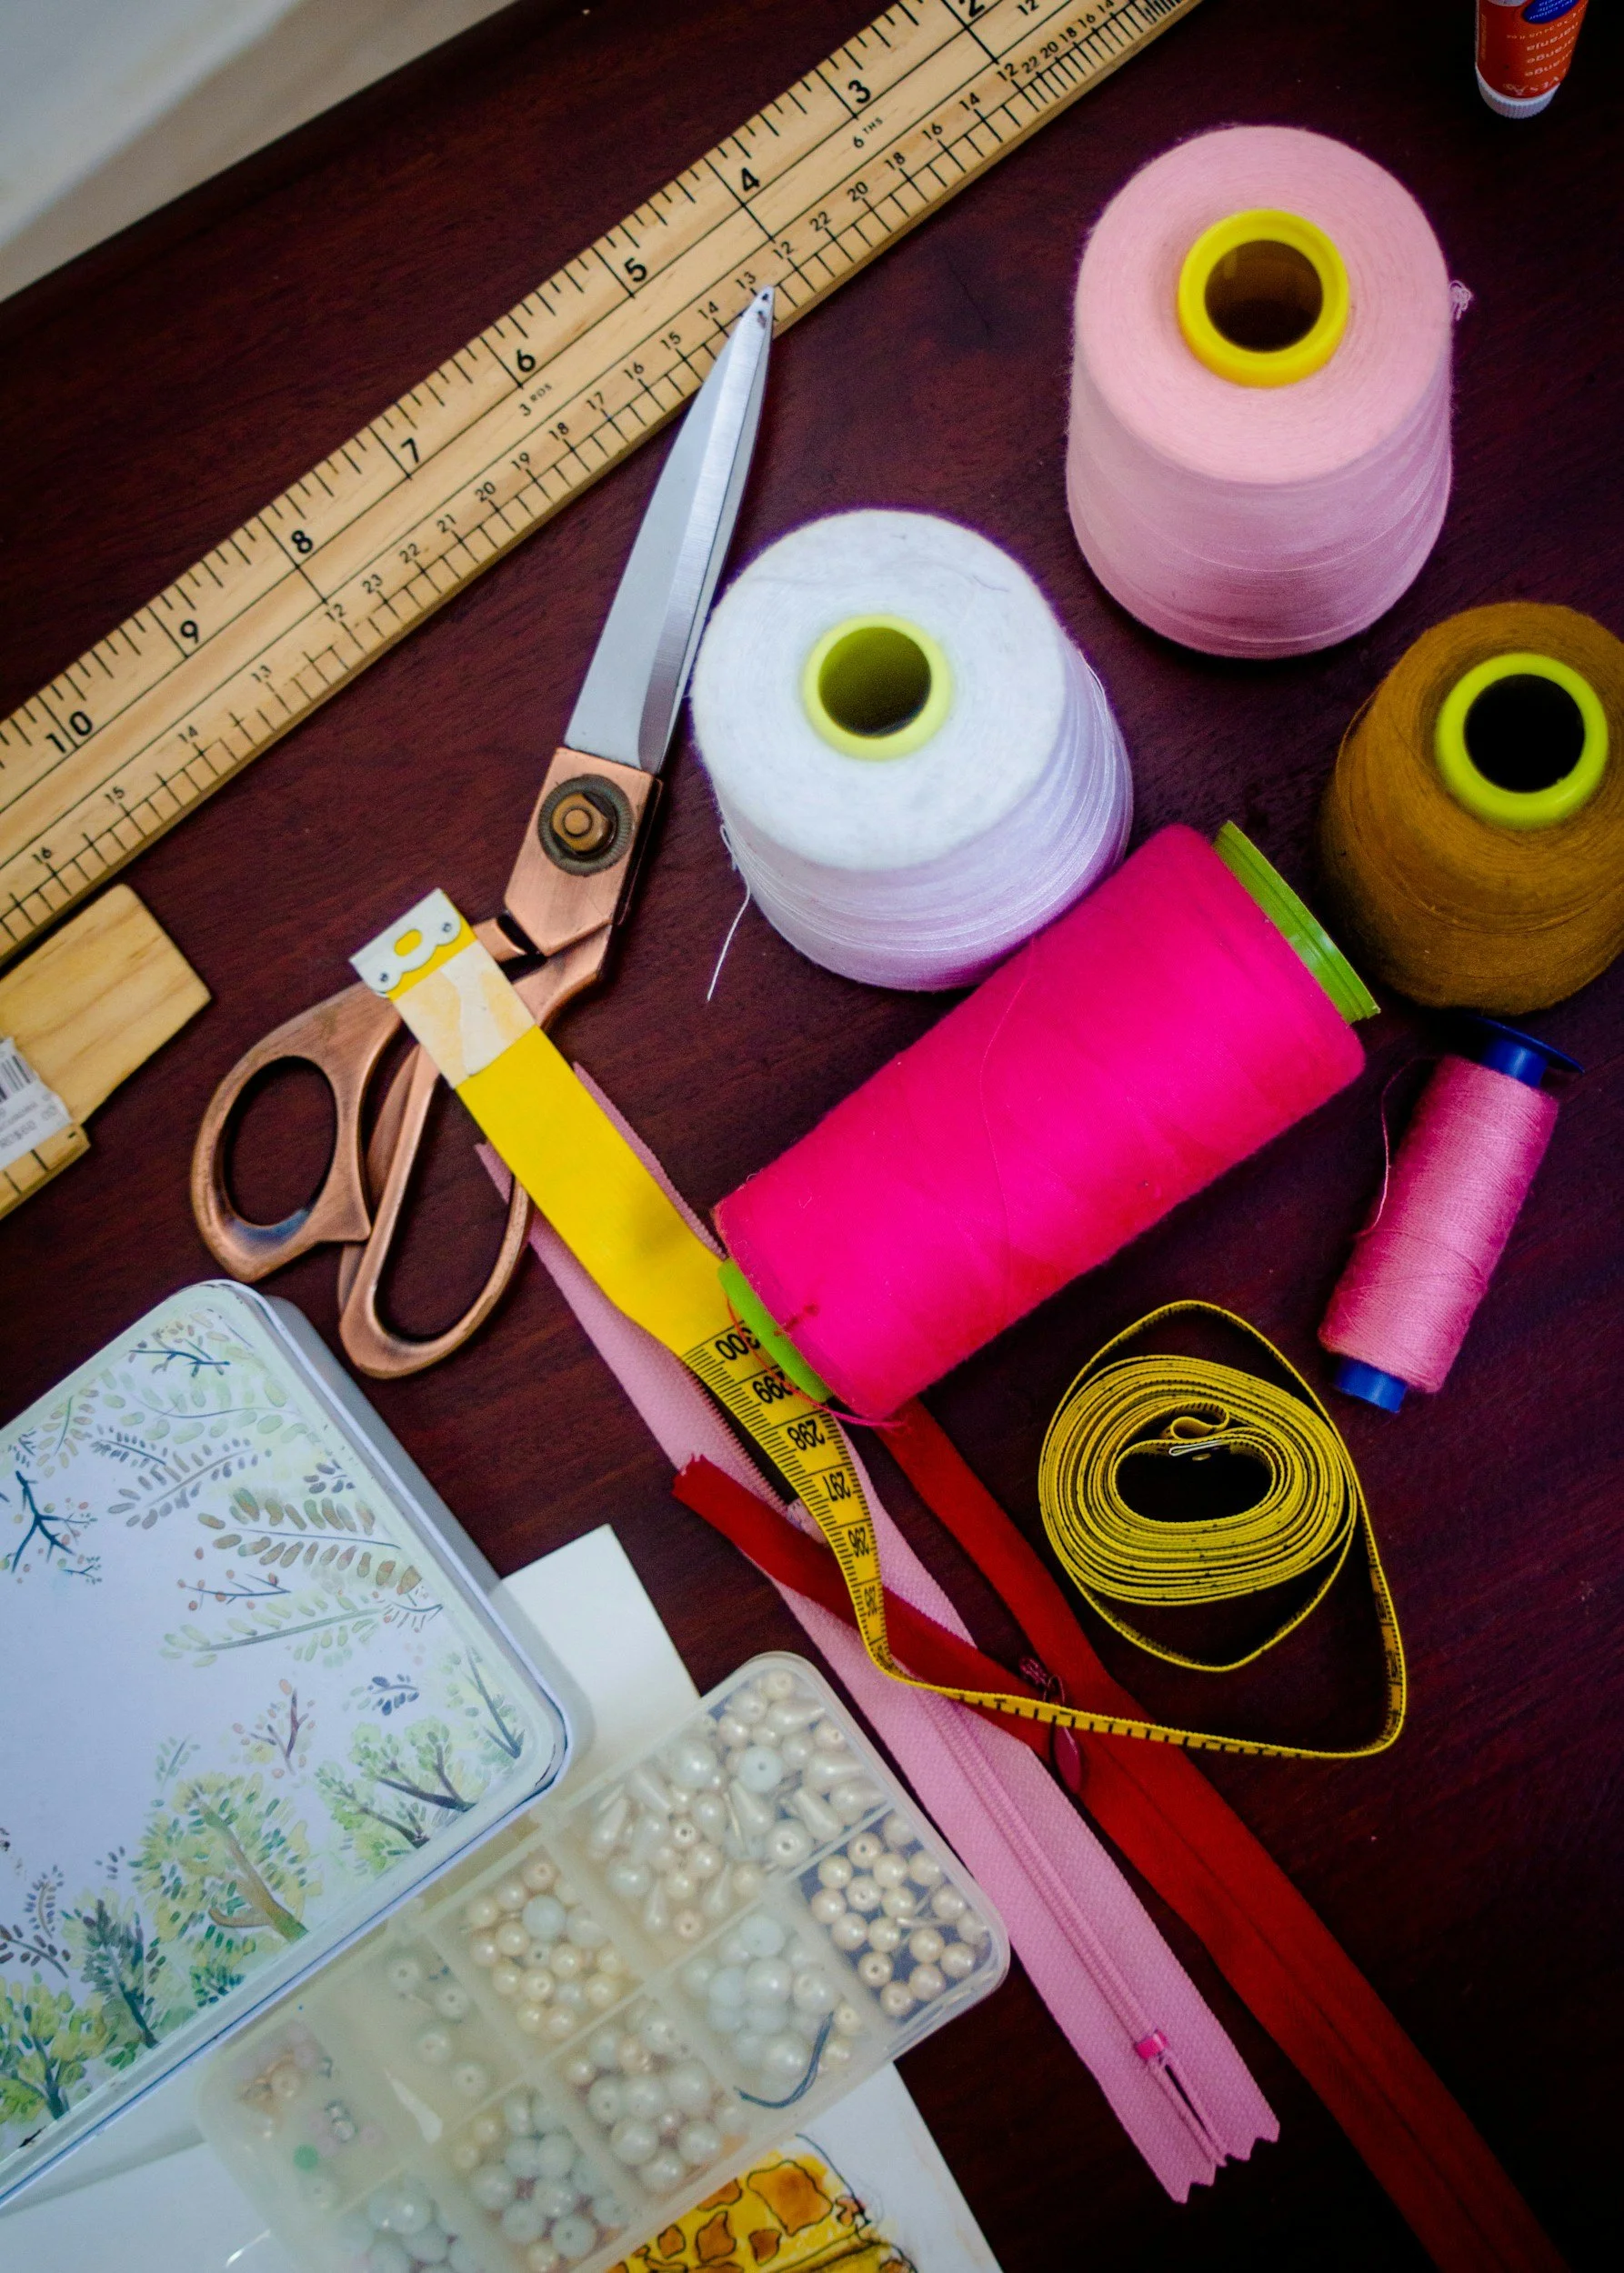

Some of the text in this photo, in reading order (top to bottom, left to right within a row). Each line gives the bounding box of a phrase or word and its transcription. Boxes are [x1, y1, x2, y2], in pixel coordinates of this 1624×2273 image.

[958, 0, 985, 17] 2
[1017, 0, 1039, 15] 12
[1097, 0, 1115, 13] 14
[1078, 14, 1096, 28] 16
[1059, 26, 1078, 43] 18
[1040, 41, 1059, 59] 20
[997, 63, 1018, 82] 12
[1021, 55, 1040, 75] 22
[847, 79, 871, 104] 3
[959, 93, 981, 111] 14
[921, 124, 943, 141] 16
[853, 136, 865, 149] 6
[884, 152, 906, 171] 18
[740, 167, 760, 192] 4
[847, 181, 869, 202] 20
[808, 211, 831, 232] 22
[772, 241, 795, 259] 12
[624, 257, 647, 282] 5
[735, 272, 757, 290] 13
[697, 301, 719, 319] 14
[659, 332, 681, 350] 15
[516, 349, 536, 373] 6
[623, 362, 645, 380] 16
[586, 392, 605, 410] 17
[548, 423, 570, 440] 18
[400, 437, 419, 464] 7
[511, 452, 530, 470] 19
[474, 481, 496, 503] 20
[436, 514, 456, 533] 21
[291, 529, 314, 555] 8
[399, 543, 421, 564] 22
[362, 574, 383, 594] 23
[324, 604, 346, 621] 12
[180, 619, 199, 645] 9
[251, 665, 273, 683] 13
[45, 710, 93, 754] 10
[178, 726, 199, 743] 14
[105, 786, 125, 804] 15
[32, 847, 53, 865] 16
[715, 1327, 761, 1361] 300
[787, 1418, 826, 1451] 298
[822, 1470, 852, 1502] 297
[847, 1527, 870, 1558] 296
